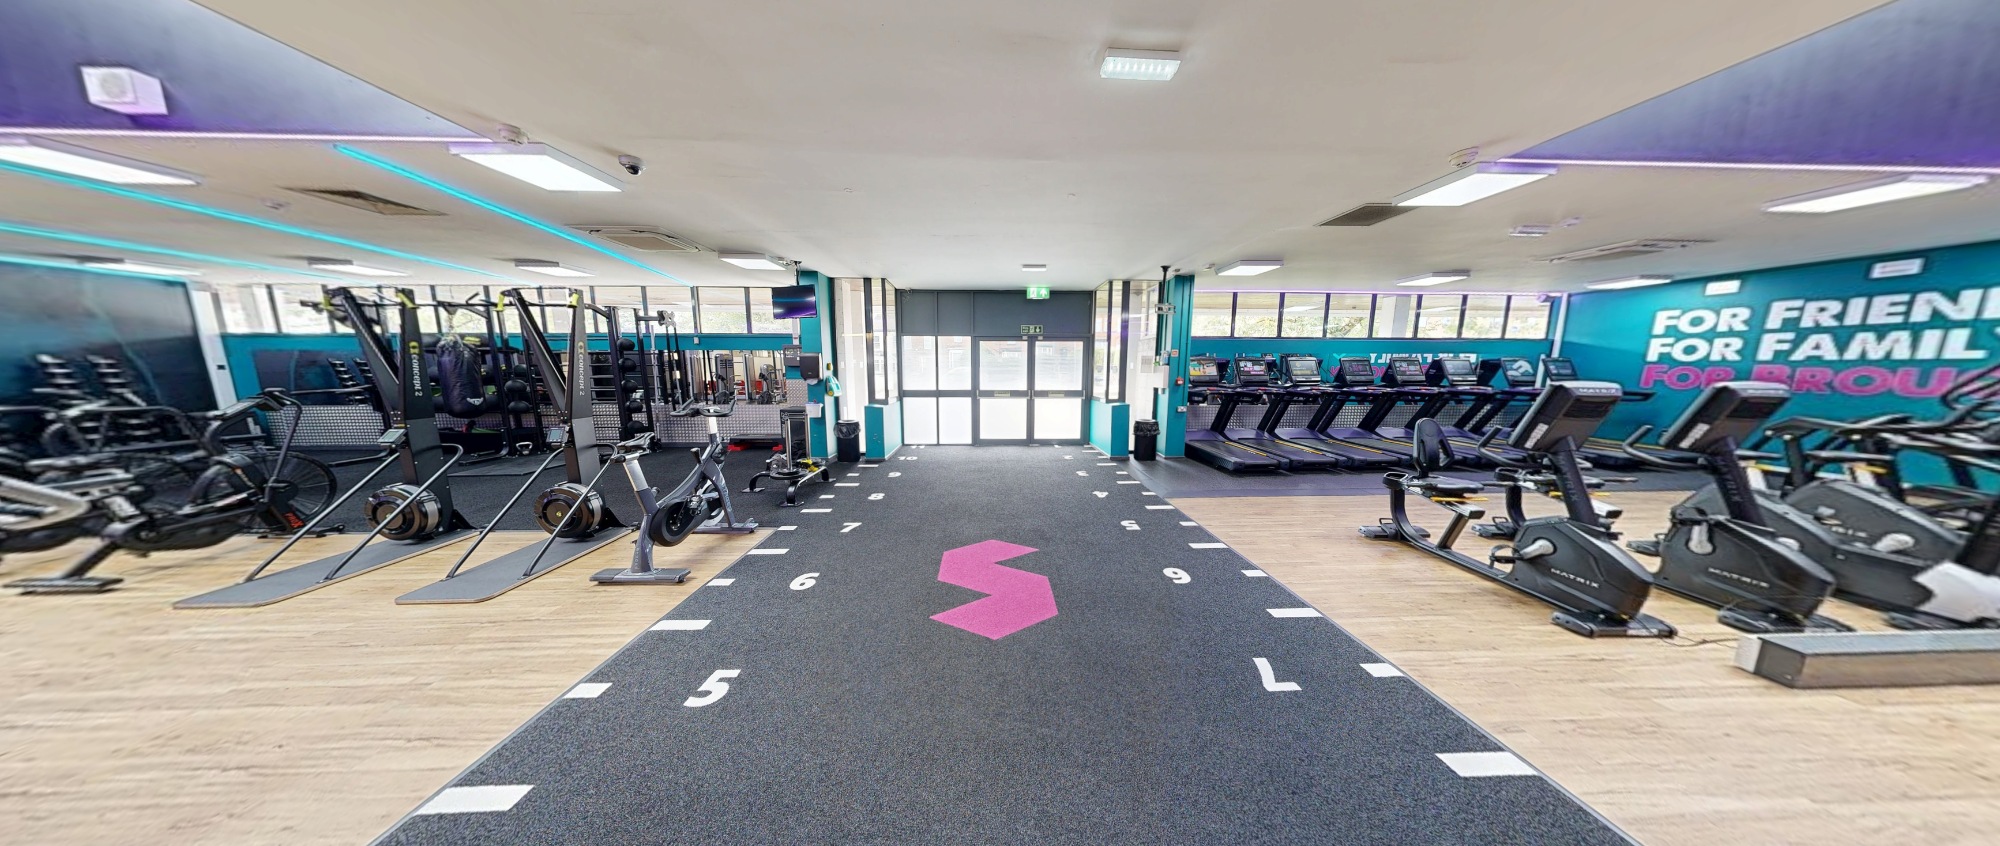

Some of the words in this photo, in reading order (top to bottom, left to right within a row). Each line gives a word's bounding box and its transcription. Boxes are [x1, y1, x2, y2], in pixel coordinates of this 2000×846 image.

[1652, 307, 1751, 335] FOR
[1646, 337, 1743, 362] FOR
[1756, 327, 2000, 362] FAMIL
[1640, 364, 1734, 390] FOR
[868, 492, 886, 501] 8
[840, 522, 862, 533] 7
[1120, 520, 1141, 531] 5
[789, 572, 820, 591] 6
[1551, 568, 1600, 588] MATRIX
[683, 669, 742, 708] 5
